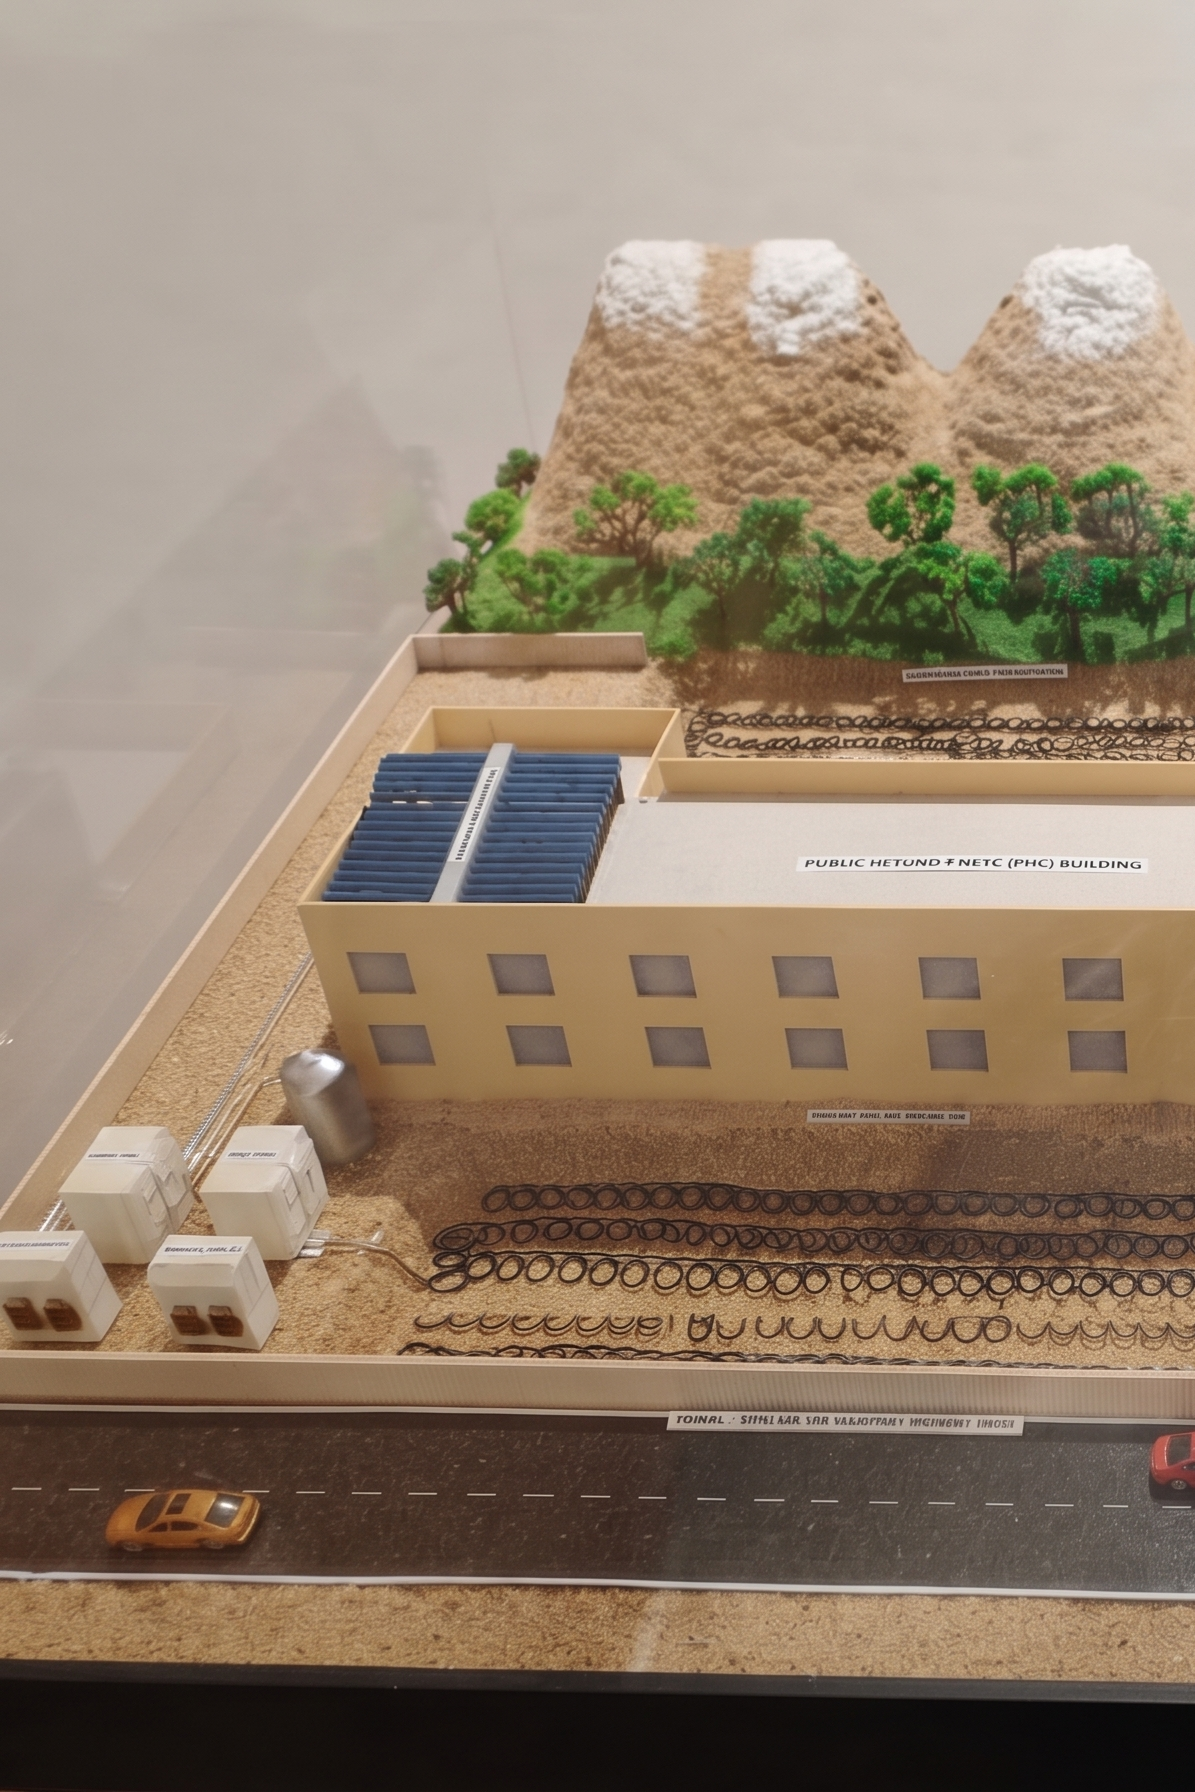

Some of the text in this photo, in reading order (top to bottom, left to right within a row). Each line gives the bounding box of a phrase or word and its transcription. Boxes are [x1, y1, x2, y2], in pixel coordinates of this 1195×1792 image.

[805, 858, 866, 868] PUBLIC
[958, 858, 1003, 867] NETC
[1007, 858, 1055, 869] (PHC)
[1059, 859, 1143, 870] BUILDING
